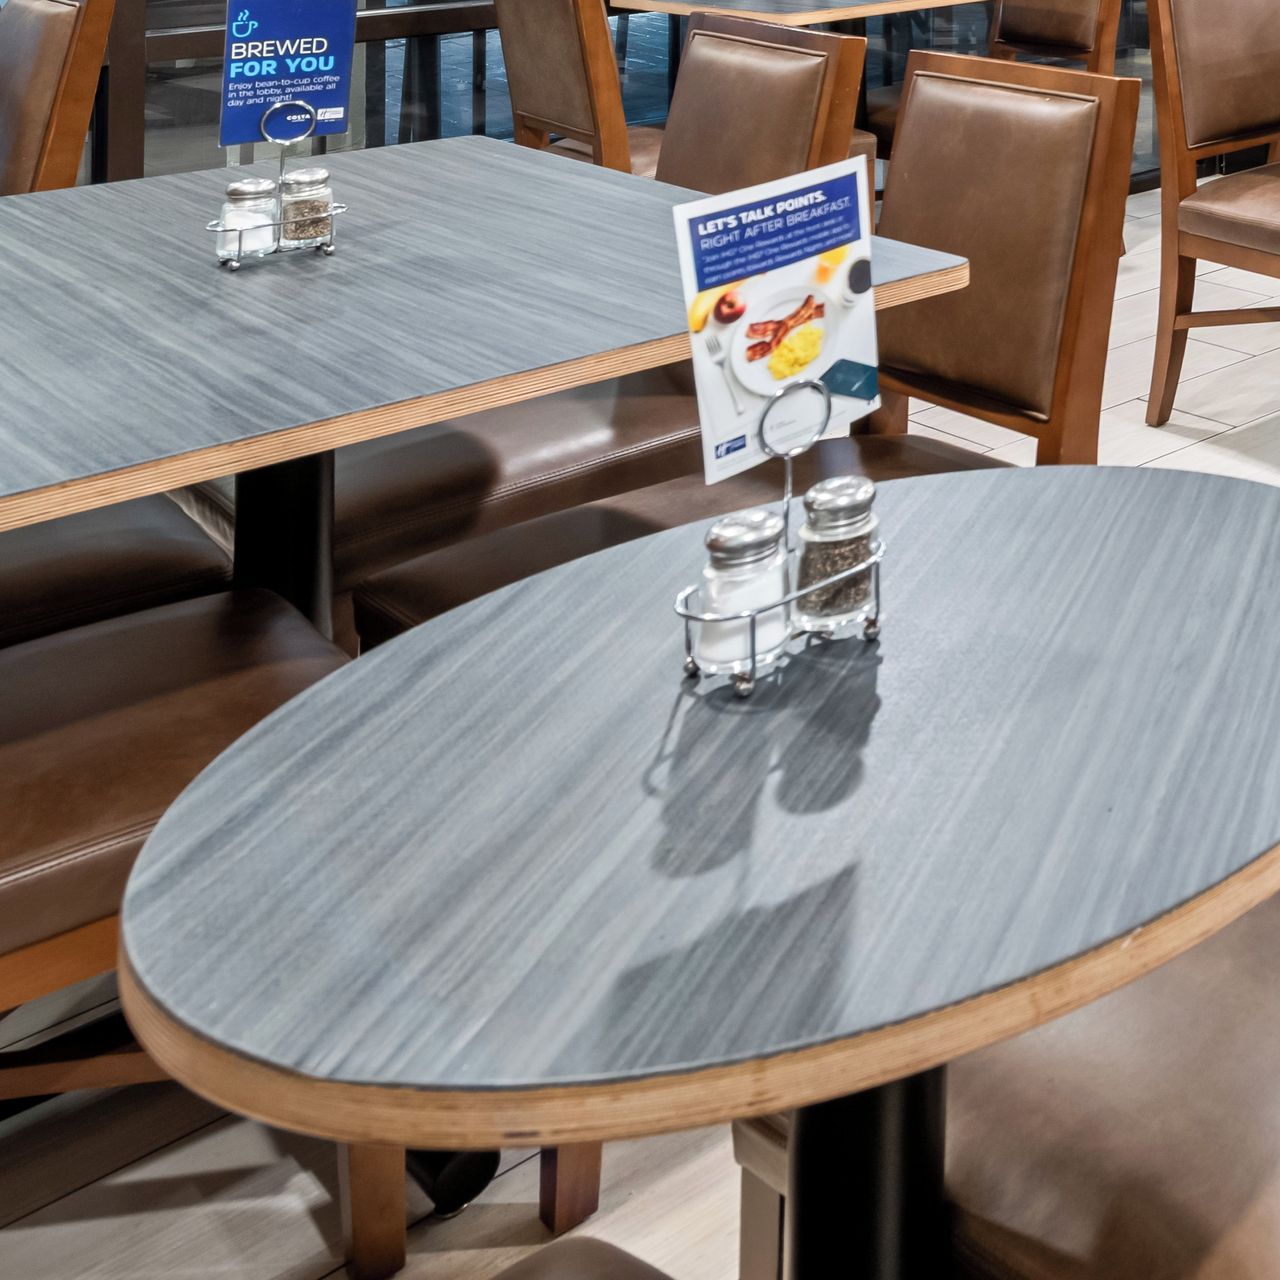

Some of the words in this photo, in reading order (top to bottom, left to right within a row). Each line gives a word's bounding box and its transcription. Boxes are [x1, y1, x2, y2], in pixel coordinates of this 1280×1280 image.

[231, 37, 328, 60] BREWED
[229, 60, 277, 78] FOR
[285, 55, 335, 73] YOU
[228, 81, 253, 92] Enjoy
[255, 77, 311, 89] bean-to-cup
[313, 75, 340, 83] coffee
[228, 90, 237, 98] in
[239, 89, 254, 97] the
[256, 86, 283, 96] lobby,
[285, 84, 324, 93] available
[227, 98, 244, 108] day
[246, 96, 264, 105] and
[266, 94, 292, 104] night!
[286, 113, 311, 121] COSTA
[698, 215, 738, 236] LET'S
[739, 204, 775, 224] TALK
[776, 190, 828, 215] POINTS.
[700, 229, 741, 251] RIGHT
[744, 218, 784, 239] AFTER
[786, 196, 851, 226] BREAKFAST.
